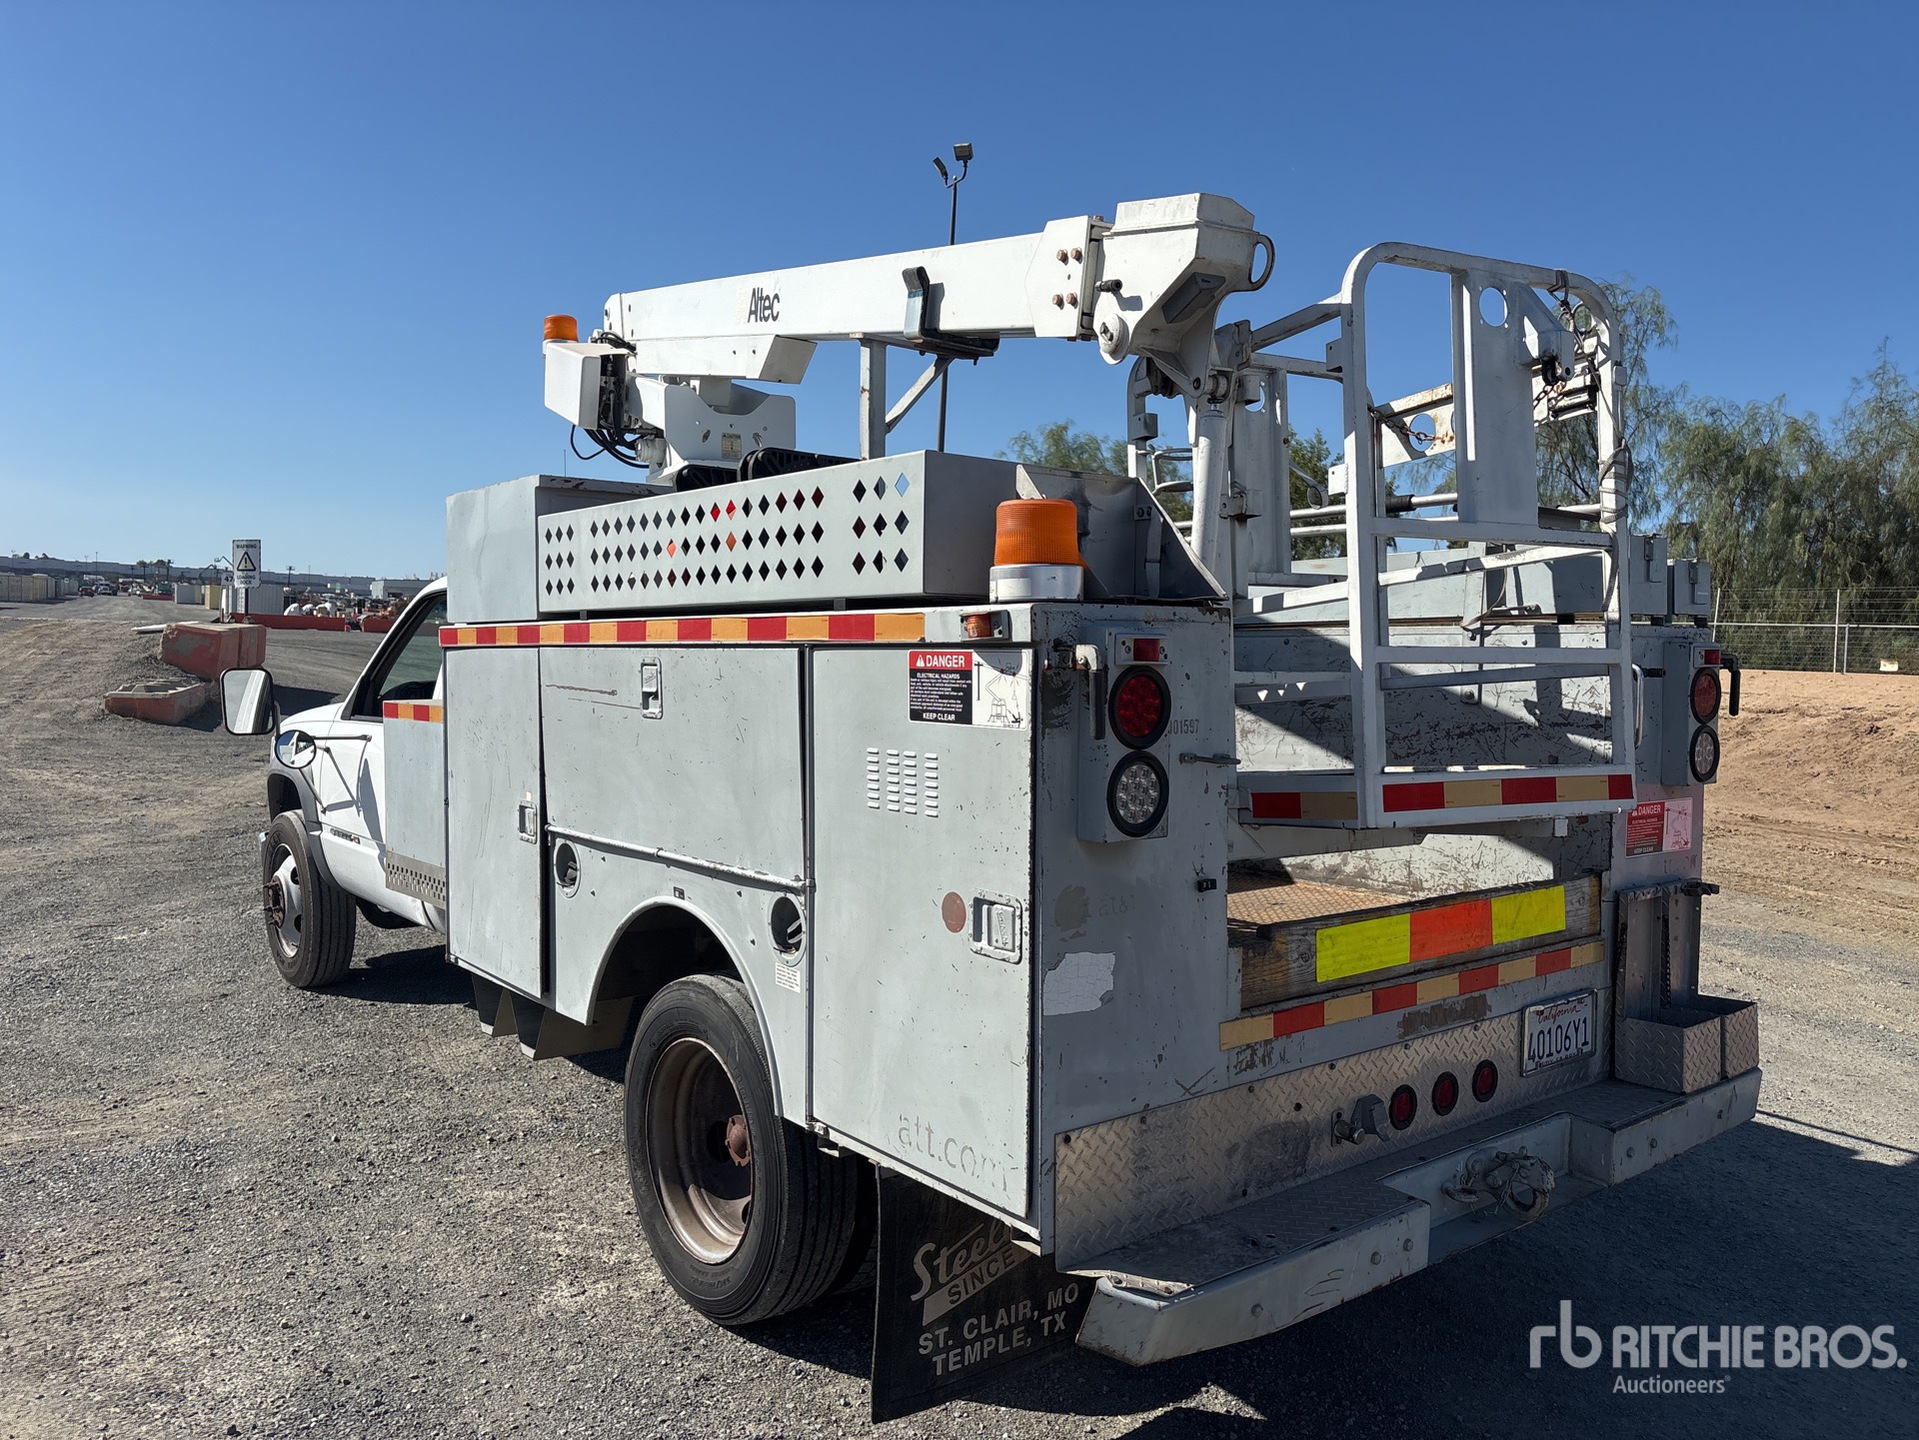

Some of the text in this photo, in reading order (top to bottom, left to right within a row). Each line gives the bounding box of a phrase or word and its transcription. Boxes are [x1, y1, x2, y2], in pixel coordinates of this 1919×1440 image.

[747, 287, 780, 323] Altec
[926, 655, 965, 667] DANGER
[937, 713, 956, 721] CLEAR
[1638, 804, 1661, 815] DANGER
[1537, 1004, 1581, 1024] California
[1528, 1016, 1590, 1063] 40106Y1
[948, 1246, 1016, 1305] SINCE
[918, 1282, 1079, 1355] ST. CLAIR, MO
[932, 1311, 1066, 1376] TEMPLE, TX
